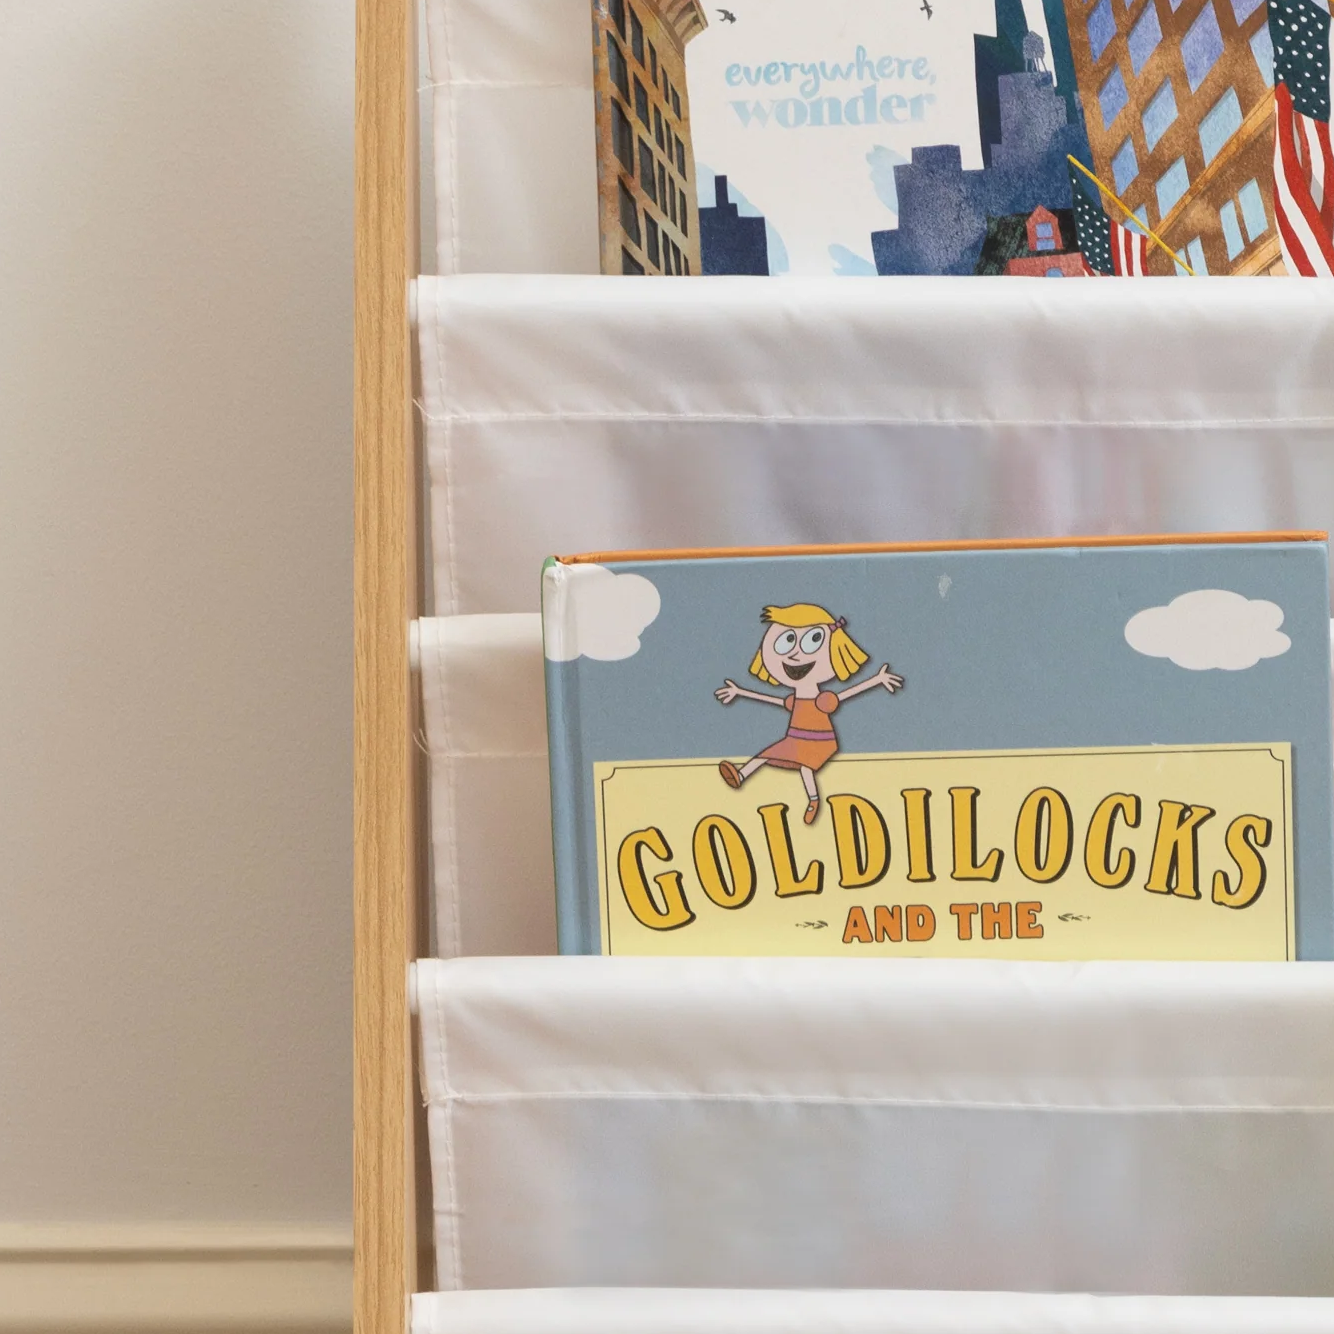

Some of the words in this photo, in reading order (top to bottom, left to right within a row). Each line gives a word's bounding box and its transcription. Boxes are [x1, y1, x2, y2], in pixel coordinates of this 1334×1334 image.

[725, 45, 937, 99] everywhere,
[727, 83, 937, 129] wonder
[617, 786, 1274, 932] GOLDILOCKS
[841, 904, 936, 943] AND
[949, 901, 1044, 941] THE
